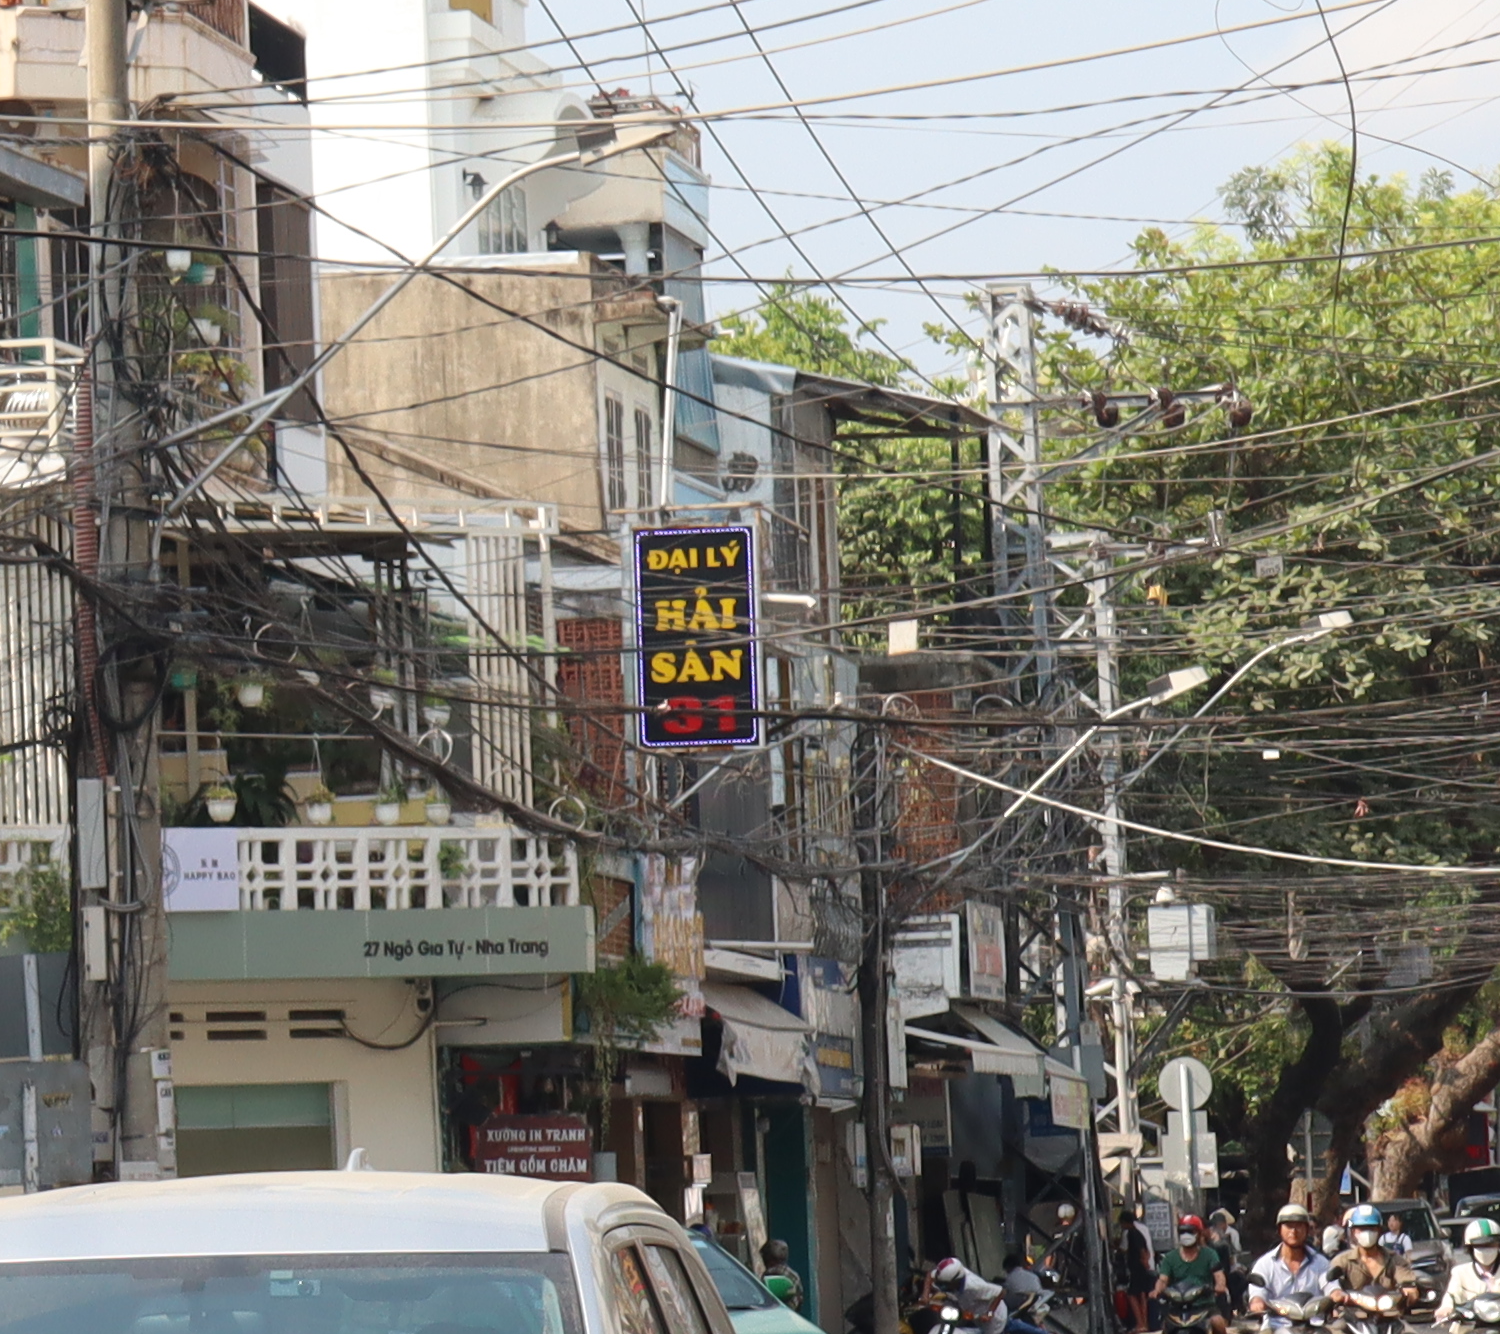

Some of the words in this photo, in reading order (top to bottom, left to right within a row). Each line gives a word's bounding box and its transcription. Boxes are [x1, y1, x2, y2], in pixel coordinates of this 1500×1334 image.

[647, 547, 698, 574] ĐẠI
[706, 540, 740, 567] LÝ
[655, 586, 737, 632] HẢI
[183, 871, 214, 881] HAPPY
[217, 871, 236, 881] BAO
[363, 941, 380, 958] 27
[383, 939, 413, 961] Ngô
[417, 940, 444, 956] Gia
[447, 939, 465, 960] Tự
[475, 939, 504, 955] Nha
[507, 938, 550, 958] Trang
[529, 1129, 542, 1142] IN
[545, 1128, 586, 1142] TRANH
[519, 1153, 547, 1173] GỐM
